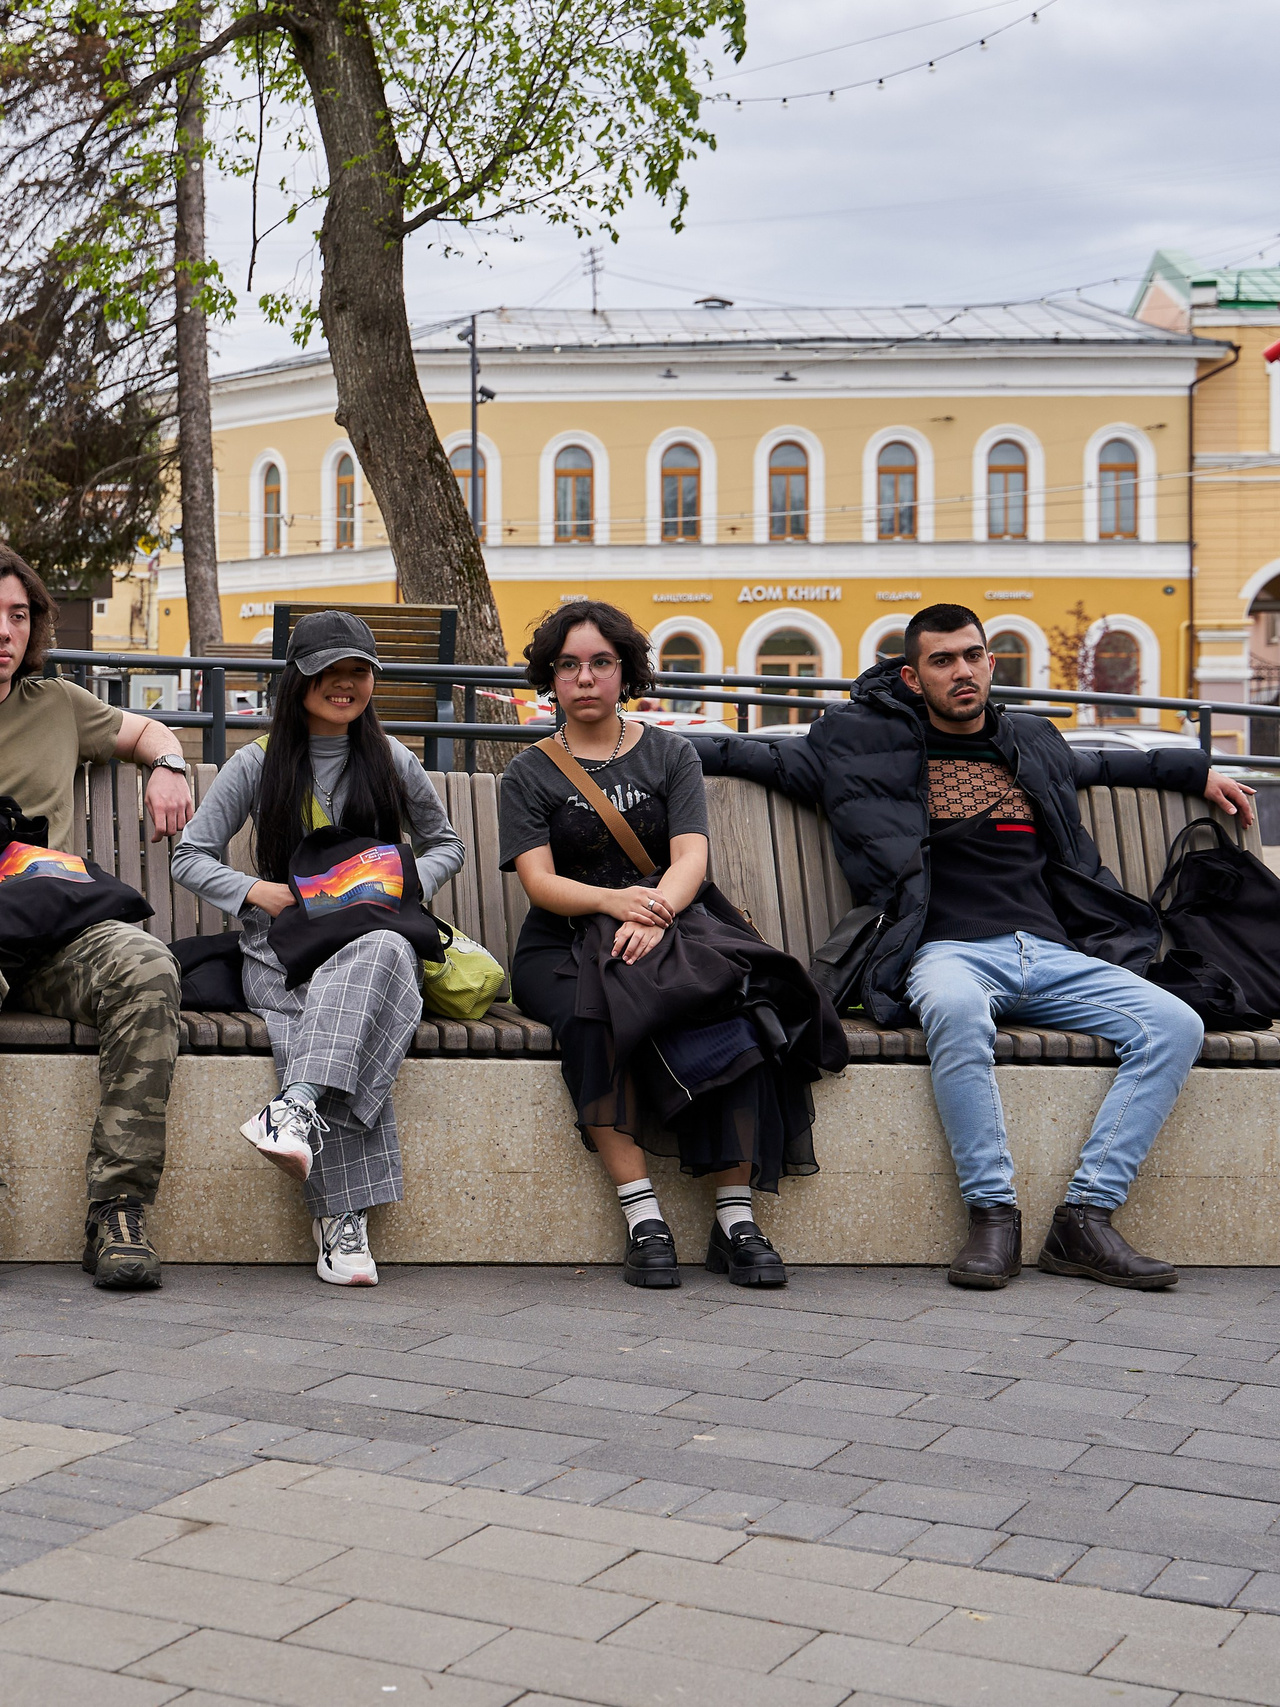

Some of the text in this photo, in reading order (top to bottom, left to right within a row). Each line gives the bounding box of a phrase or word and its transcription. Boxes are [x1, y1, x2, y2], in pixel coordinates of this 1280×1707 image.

[737, 585, 842, 603] ДОМ КНИГИ
[239, 602, 264, 618] ДОМ
